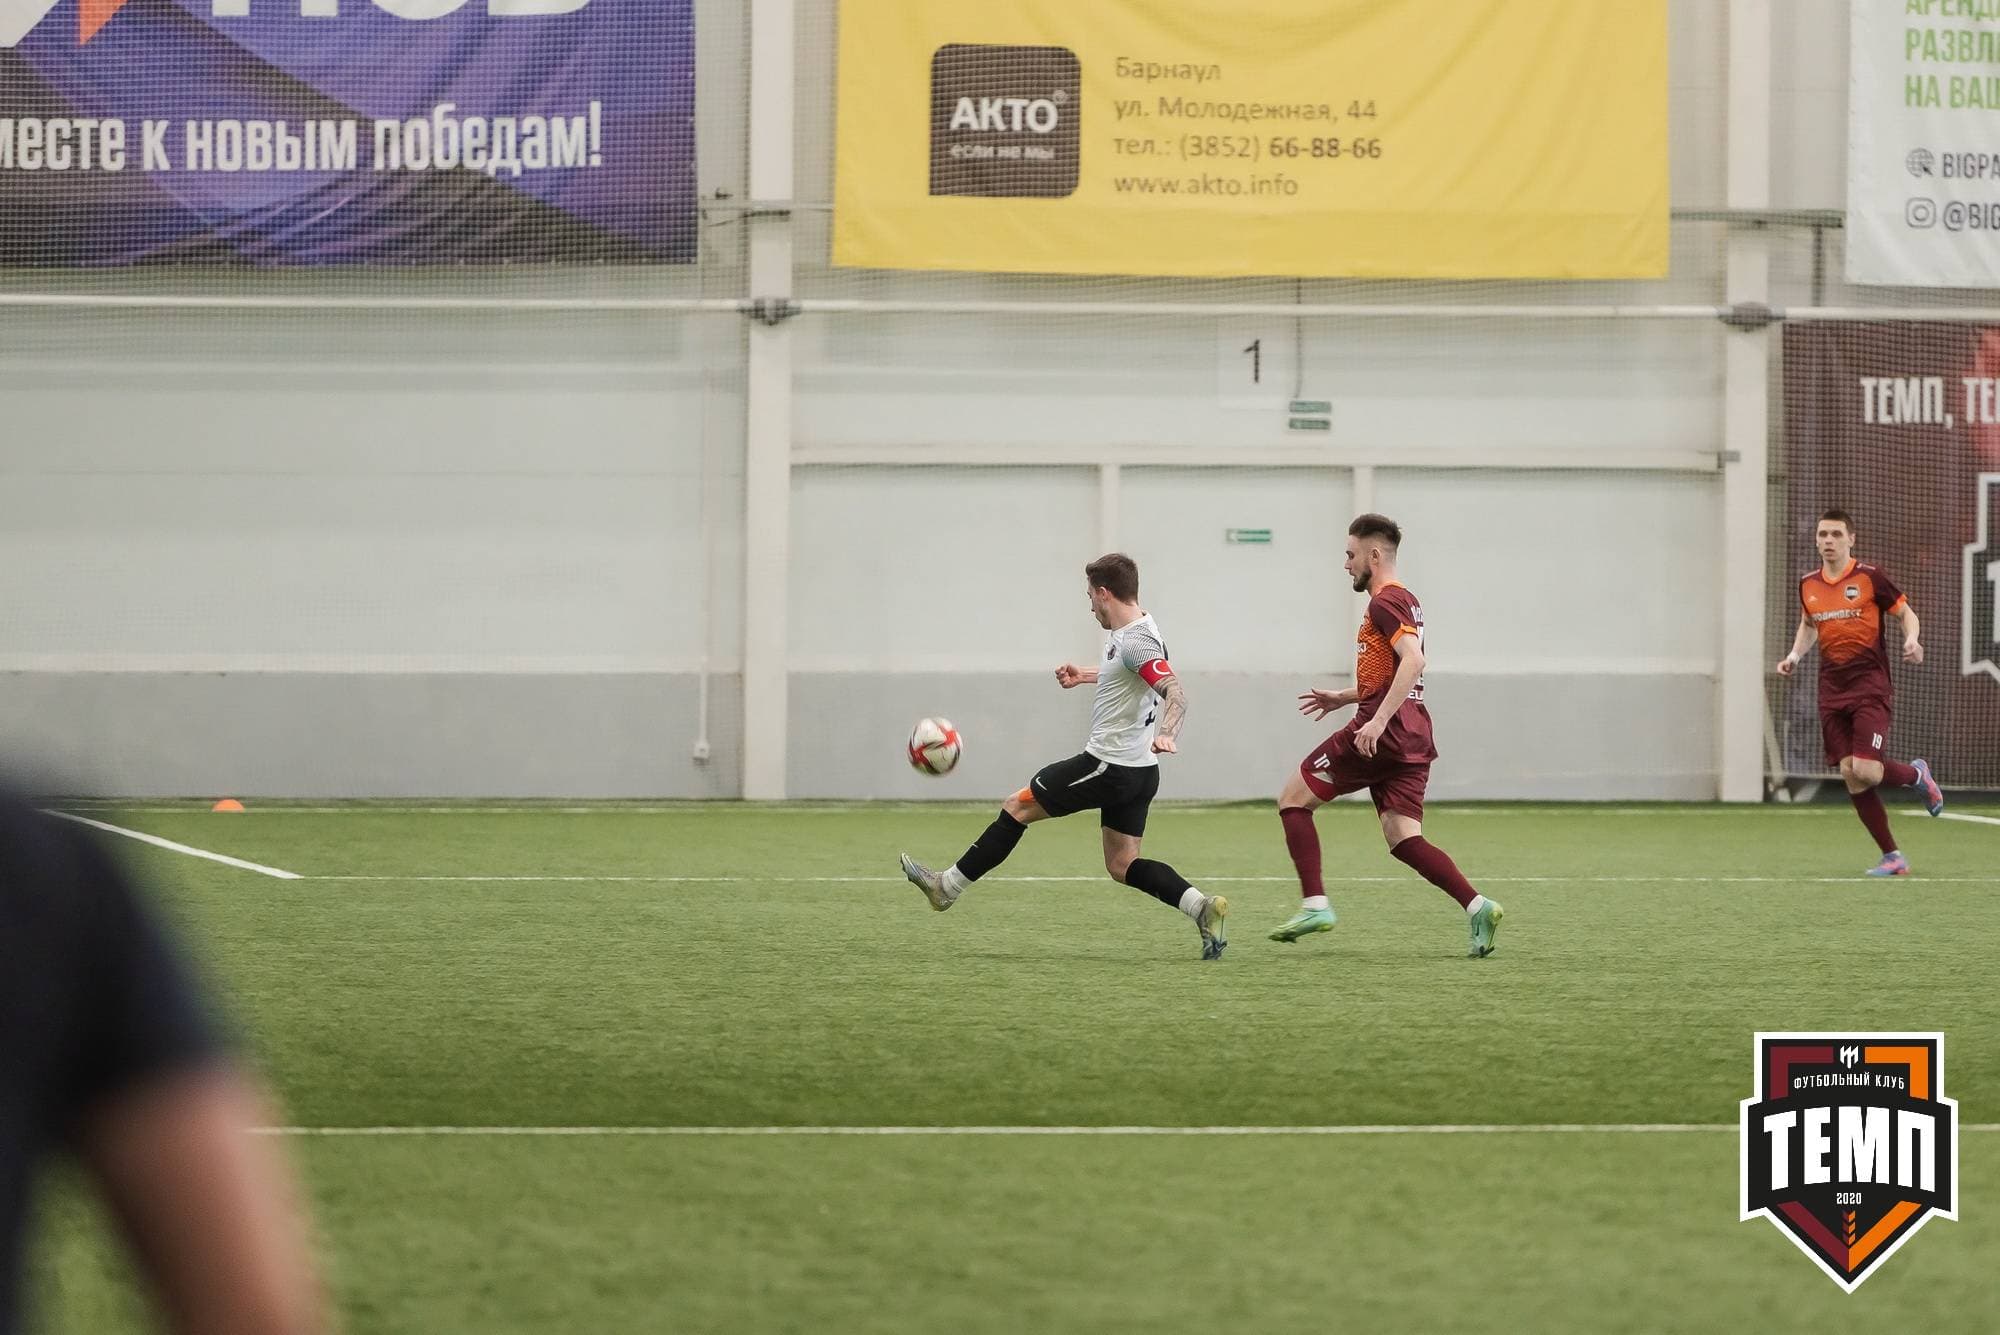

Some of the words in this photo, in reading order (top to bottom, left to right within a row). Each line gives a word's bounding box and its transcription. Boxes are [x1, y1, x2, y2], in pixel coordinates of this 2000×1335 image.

[1905, 28, 2000, 63] РАЗВЛ
[1116, 56, 1221, 84] Барнаул
[1905, 74, 1940, 108] НА
[1114, 99, 1150, 121] ул.
[1159, 97, 1338, 124] Молодежная,
[1347, 100, 1377, 118] 44
[186, 119, 357, 171] новым
[374, 101, 601, 176] победам!
[1113, 138, 1171, 155] тел.:
[1180, 133, 1260, 162] (3852)
[1270, 137, 1382, 158] 66-88-66
[1114, 173, 1298, 196] www.akto.info
[1243, 339, 1261, 383] 1
[1861, 377, 1953, 430] ТЕМП,
[1962, 377, 2000, 424] ТЕ
[1872, 733, 1883, 750] 19
